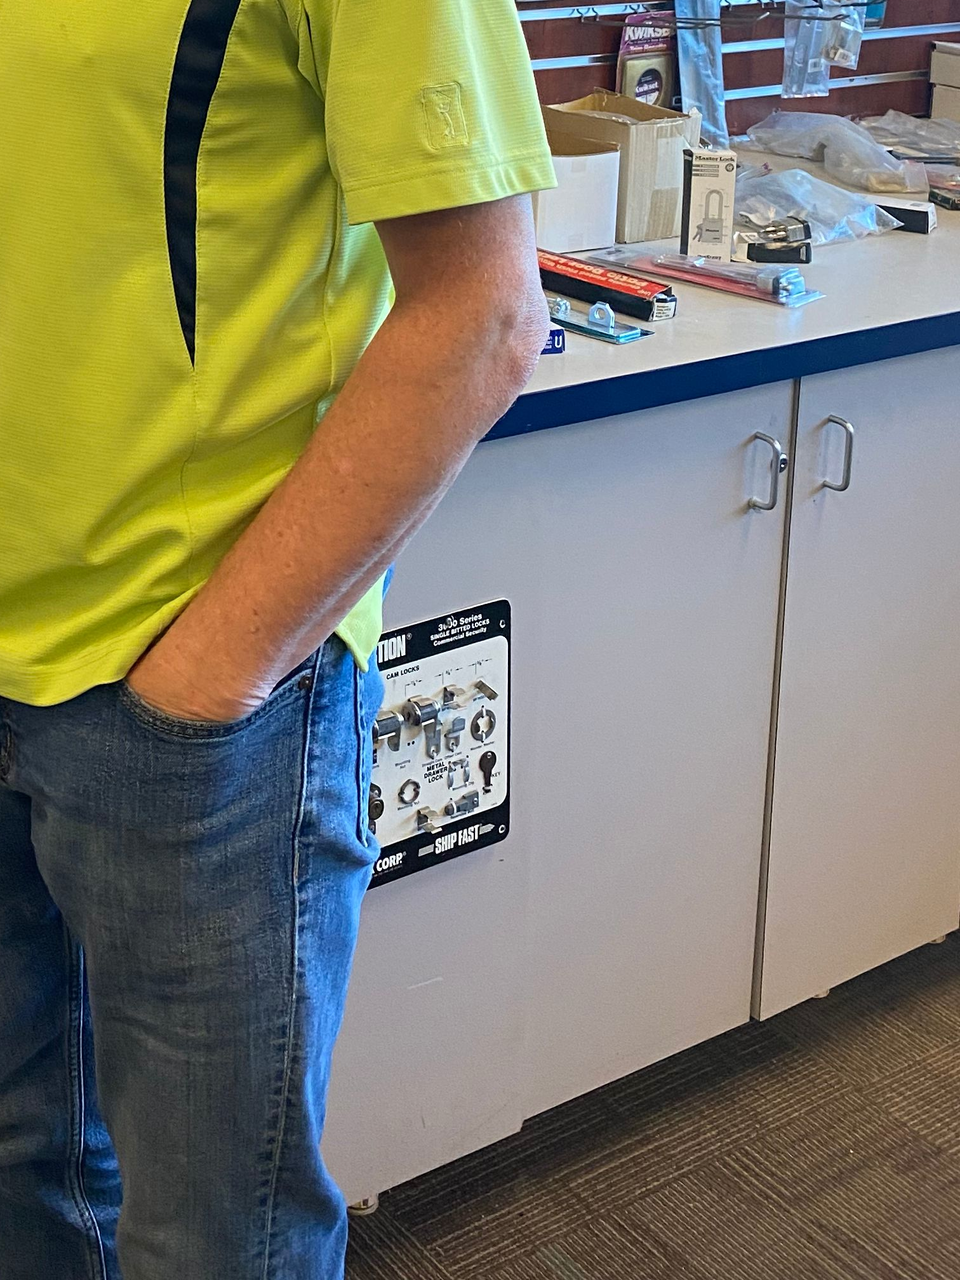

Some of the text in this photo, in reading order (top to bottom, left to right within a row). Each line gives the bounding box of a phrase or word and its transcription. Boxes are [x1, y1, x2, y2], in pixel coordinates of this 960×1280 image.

[636, 82, 658, 93] Kwikset
[460, 614, 482, 625] Series
[430, 619, 490, 641] SINGLE BITTED LOCKS
[377, 634, 406, 664] TION
[386, 665, 420, 680] CAM LOCKS
[424, 766, 448, 779] DRAWER
[427, 762, 445, 772] METAL
[428, 774, 443, 783] LOCK
[435, 824, 480, 854] SHIP FAST
